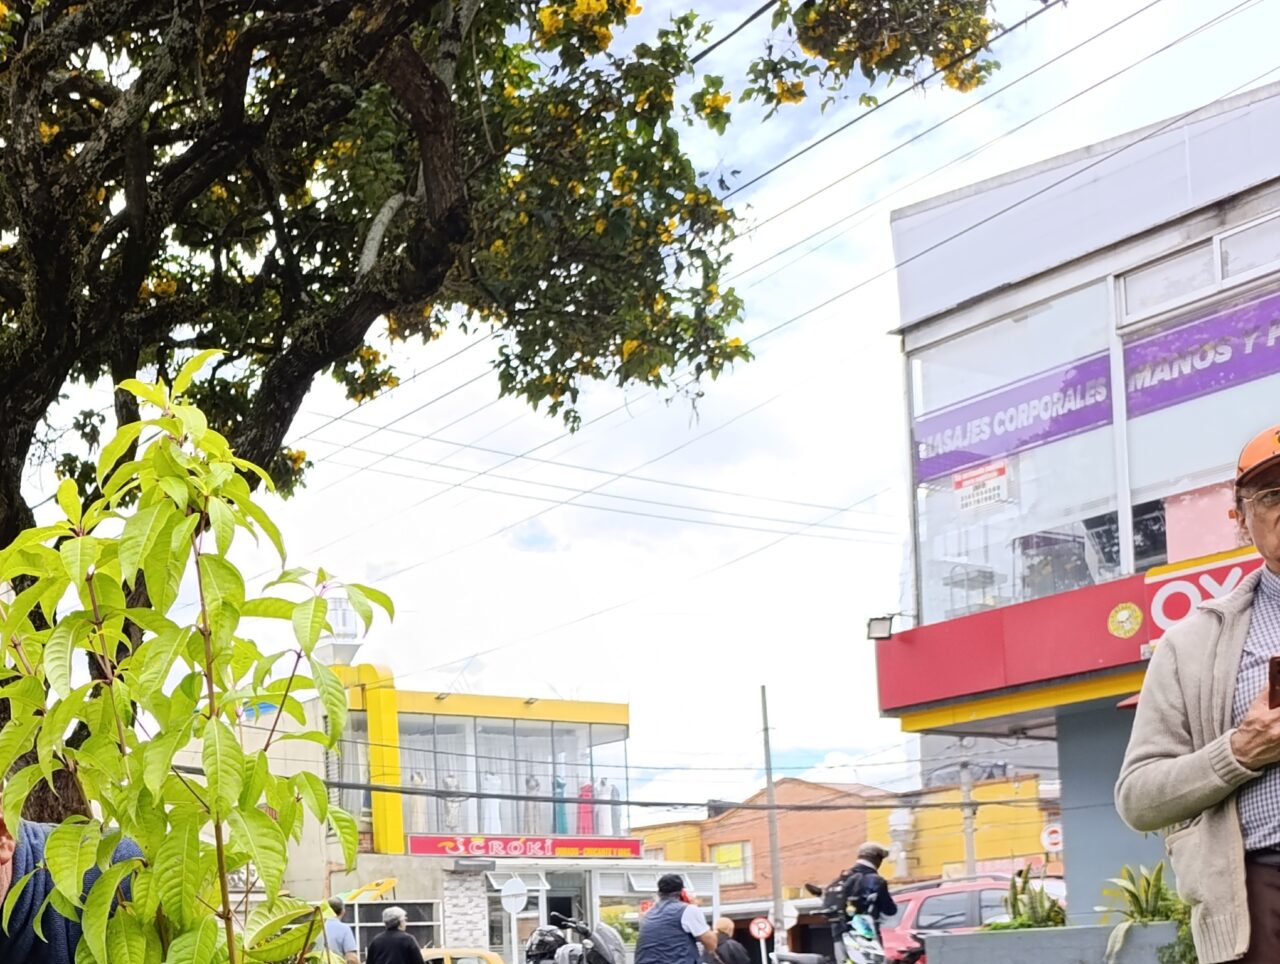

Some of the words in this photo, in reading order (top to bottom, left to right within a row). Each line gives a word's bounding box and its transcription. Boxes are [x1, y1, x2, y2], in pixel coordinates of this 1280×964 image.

[1127, 338, 1233, 393] MANOS
[1243, 326, 1260, 354] Y
[992, 377, 1108, 436] CORPORALES
